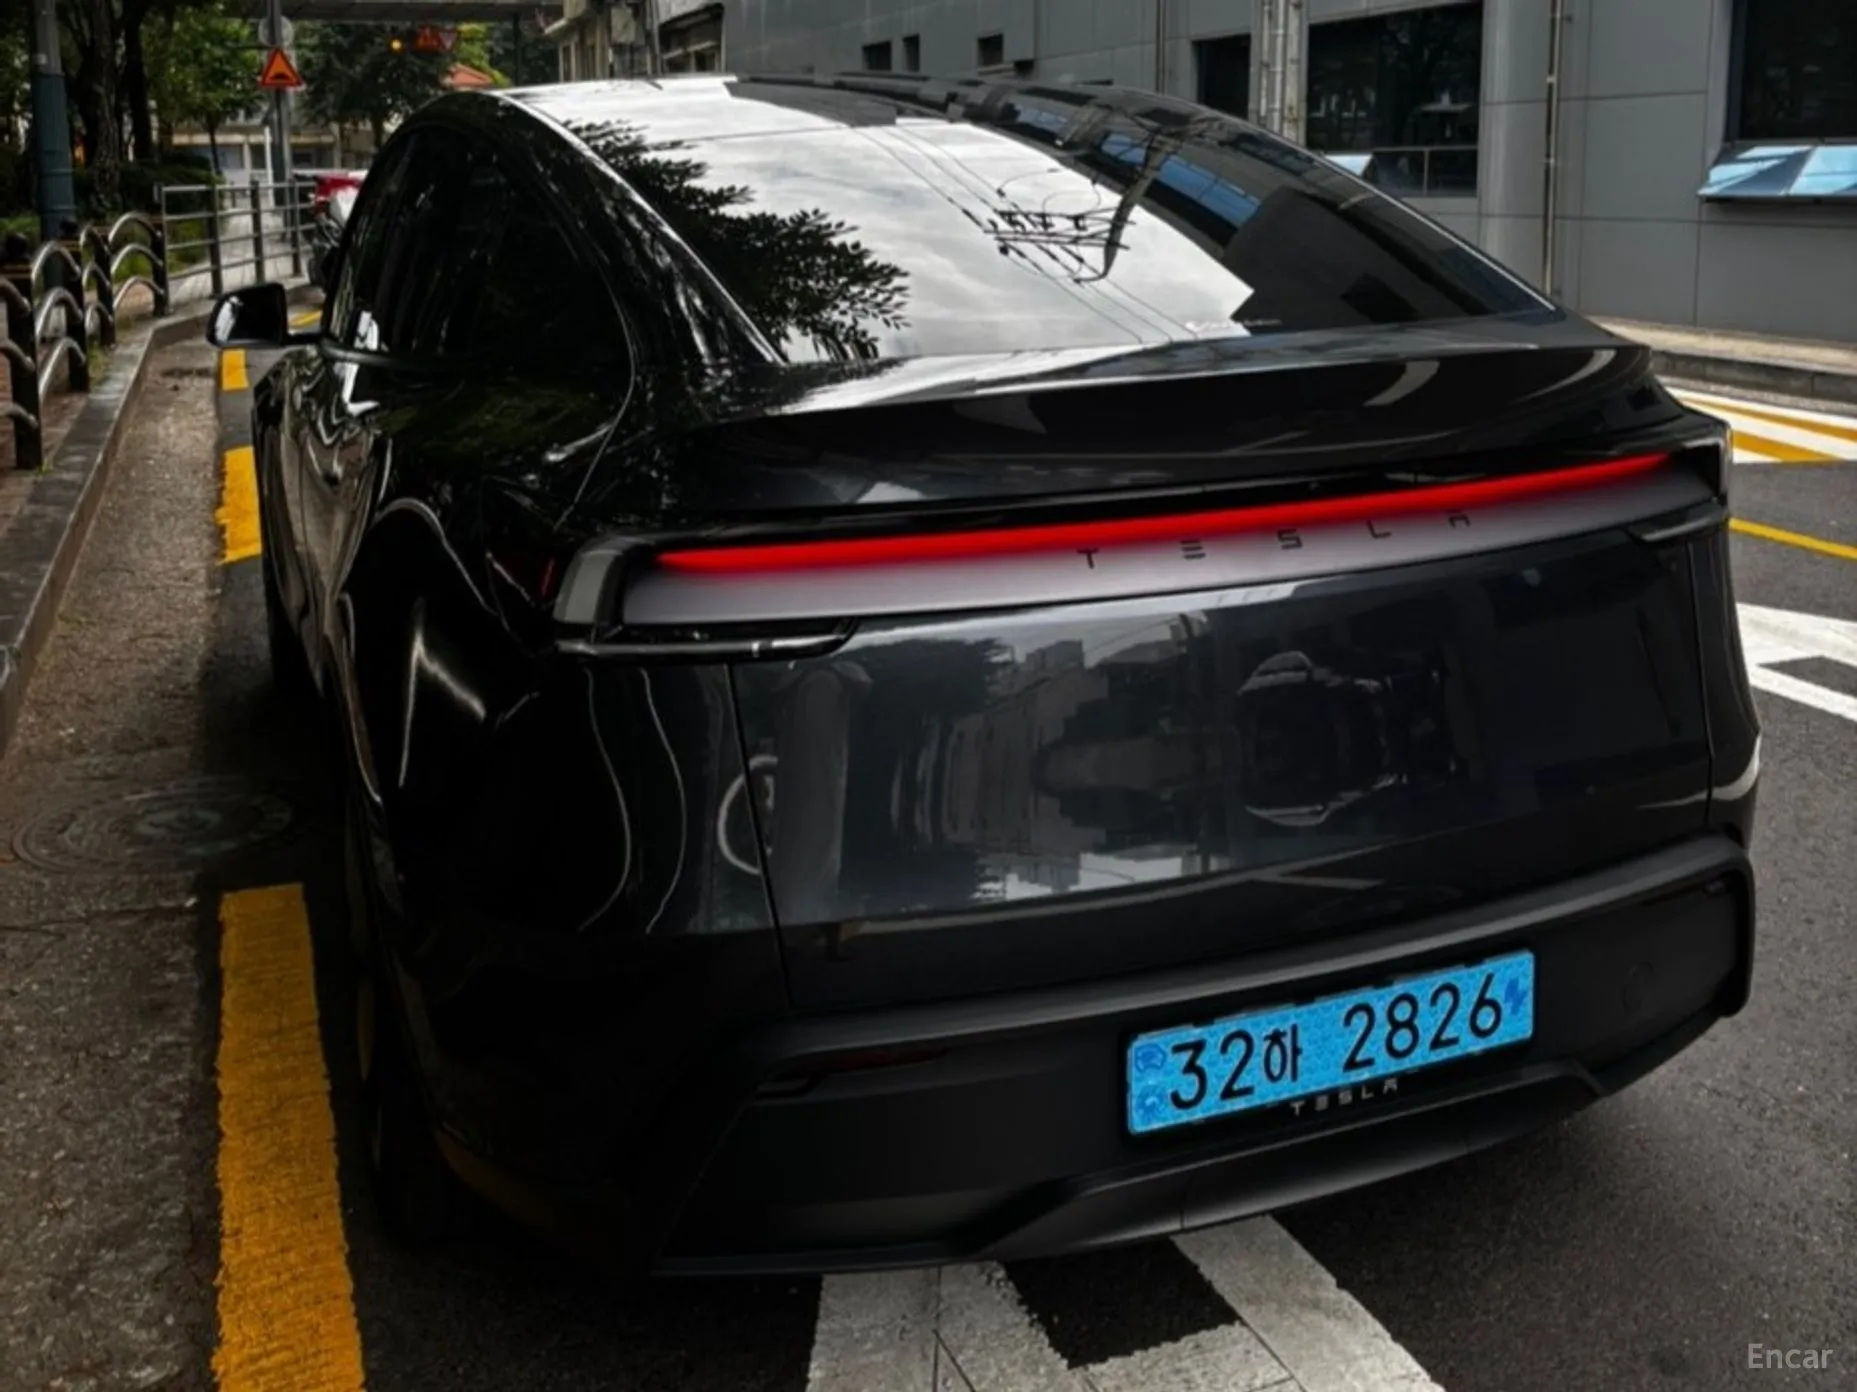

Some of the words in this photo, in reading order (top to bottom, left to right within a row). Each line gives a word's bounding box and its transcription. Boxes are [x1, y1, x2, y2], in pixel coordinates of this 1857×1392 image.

[1077, 509, 1471, 568] TESLA
[1170, 1023, 1303, 1109] 32하
[1342, 973, 1502, 1072] 2826
[1290, 1078, 1398, 1116] TESLA
